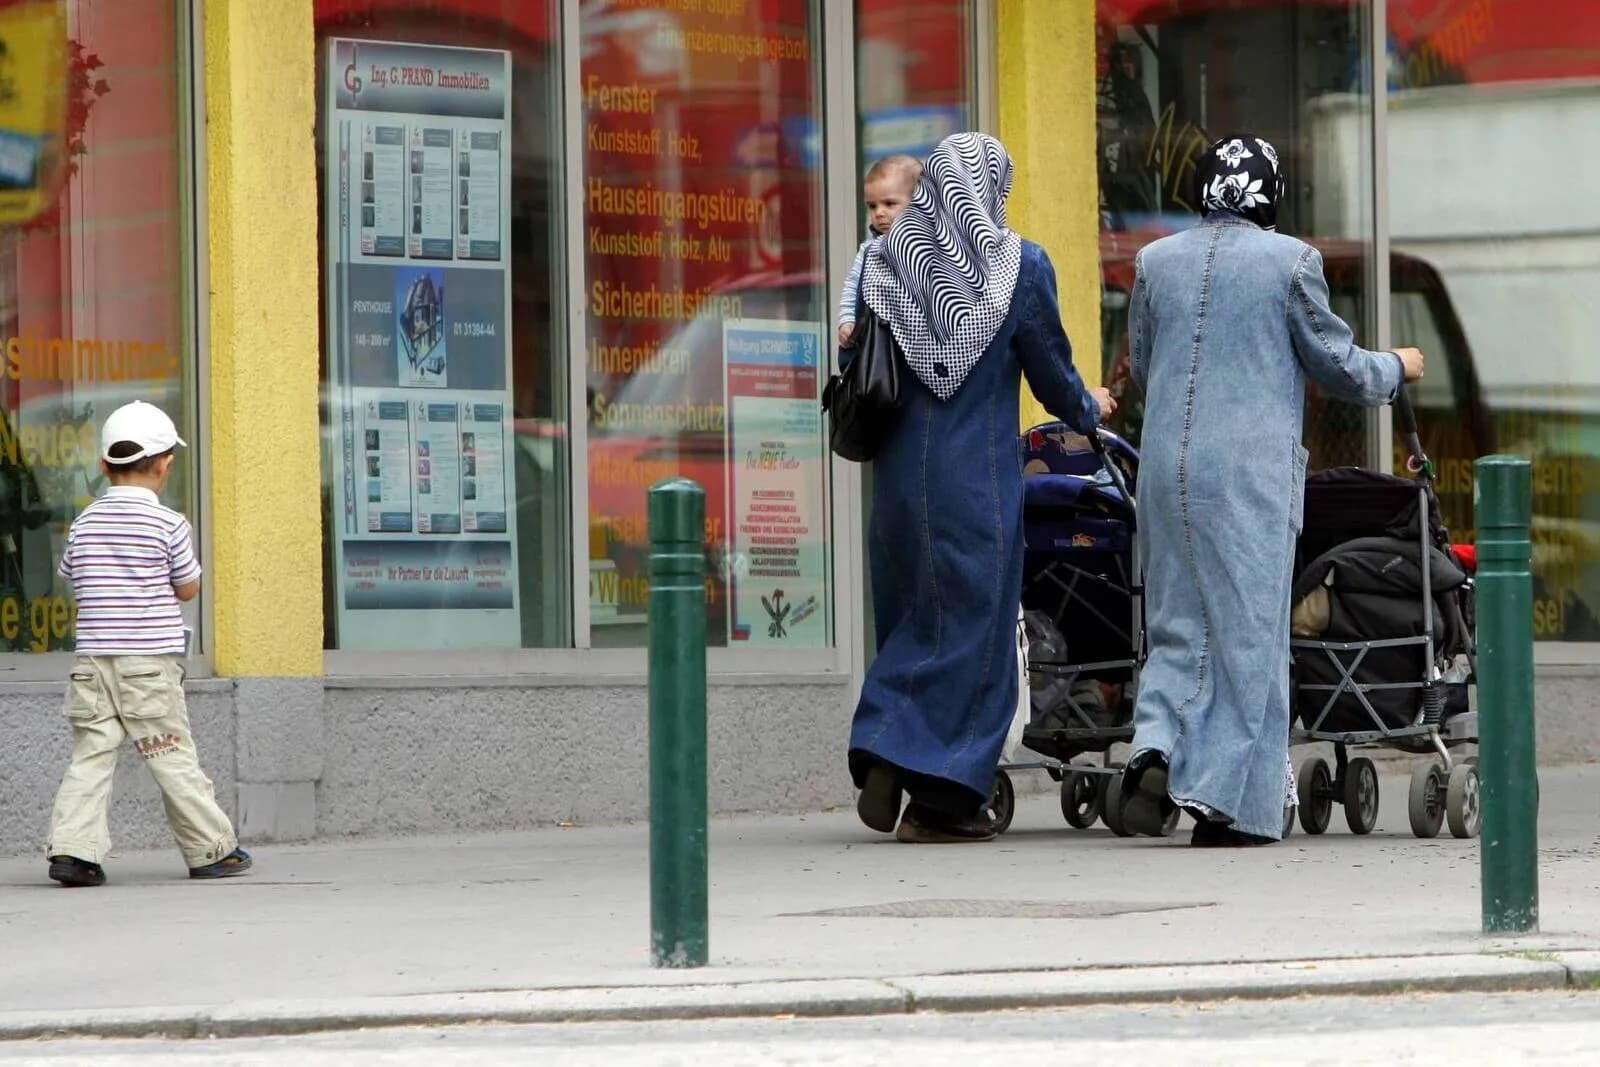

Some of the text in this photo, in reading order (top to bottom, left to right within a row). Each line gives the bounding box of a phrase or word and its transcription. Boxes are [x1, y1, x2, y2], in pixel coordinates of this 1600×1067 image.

[401, 67, 434, 88] PRAND
[437, 69, 491, 91] Immobilien
[587, 74, 658, 113] Fenster
[587, 122, 703, 161] Kunststoff, Holz,
[588, 176, 767, 229] Hauseingangstüren
[589, 226, 731, 264] Kunststoff, Holz, Alu
[352, 300, 393, 314] PENTHOUSE
[591, 279, 744, 323] Sicherheitstüren
[592, 336, 691, 375] Innentüren
[594, 391, 725, 432] Sonnenschutz
